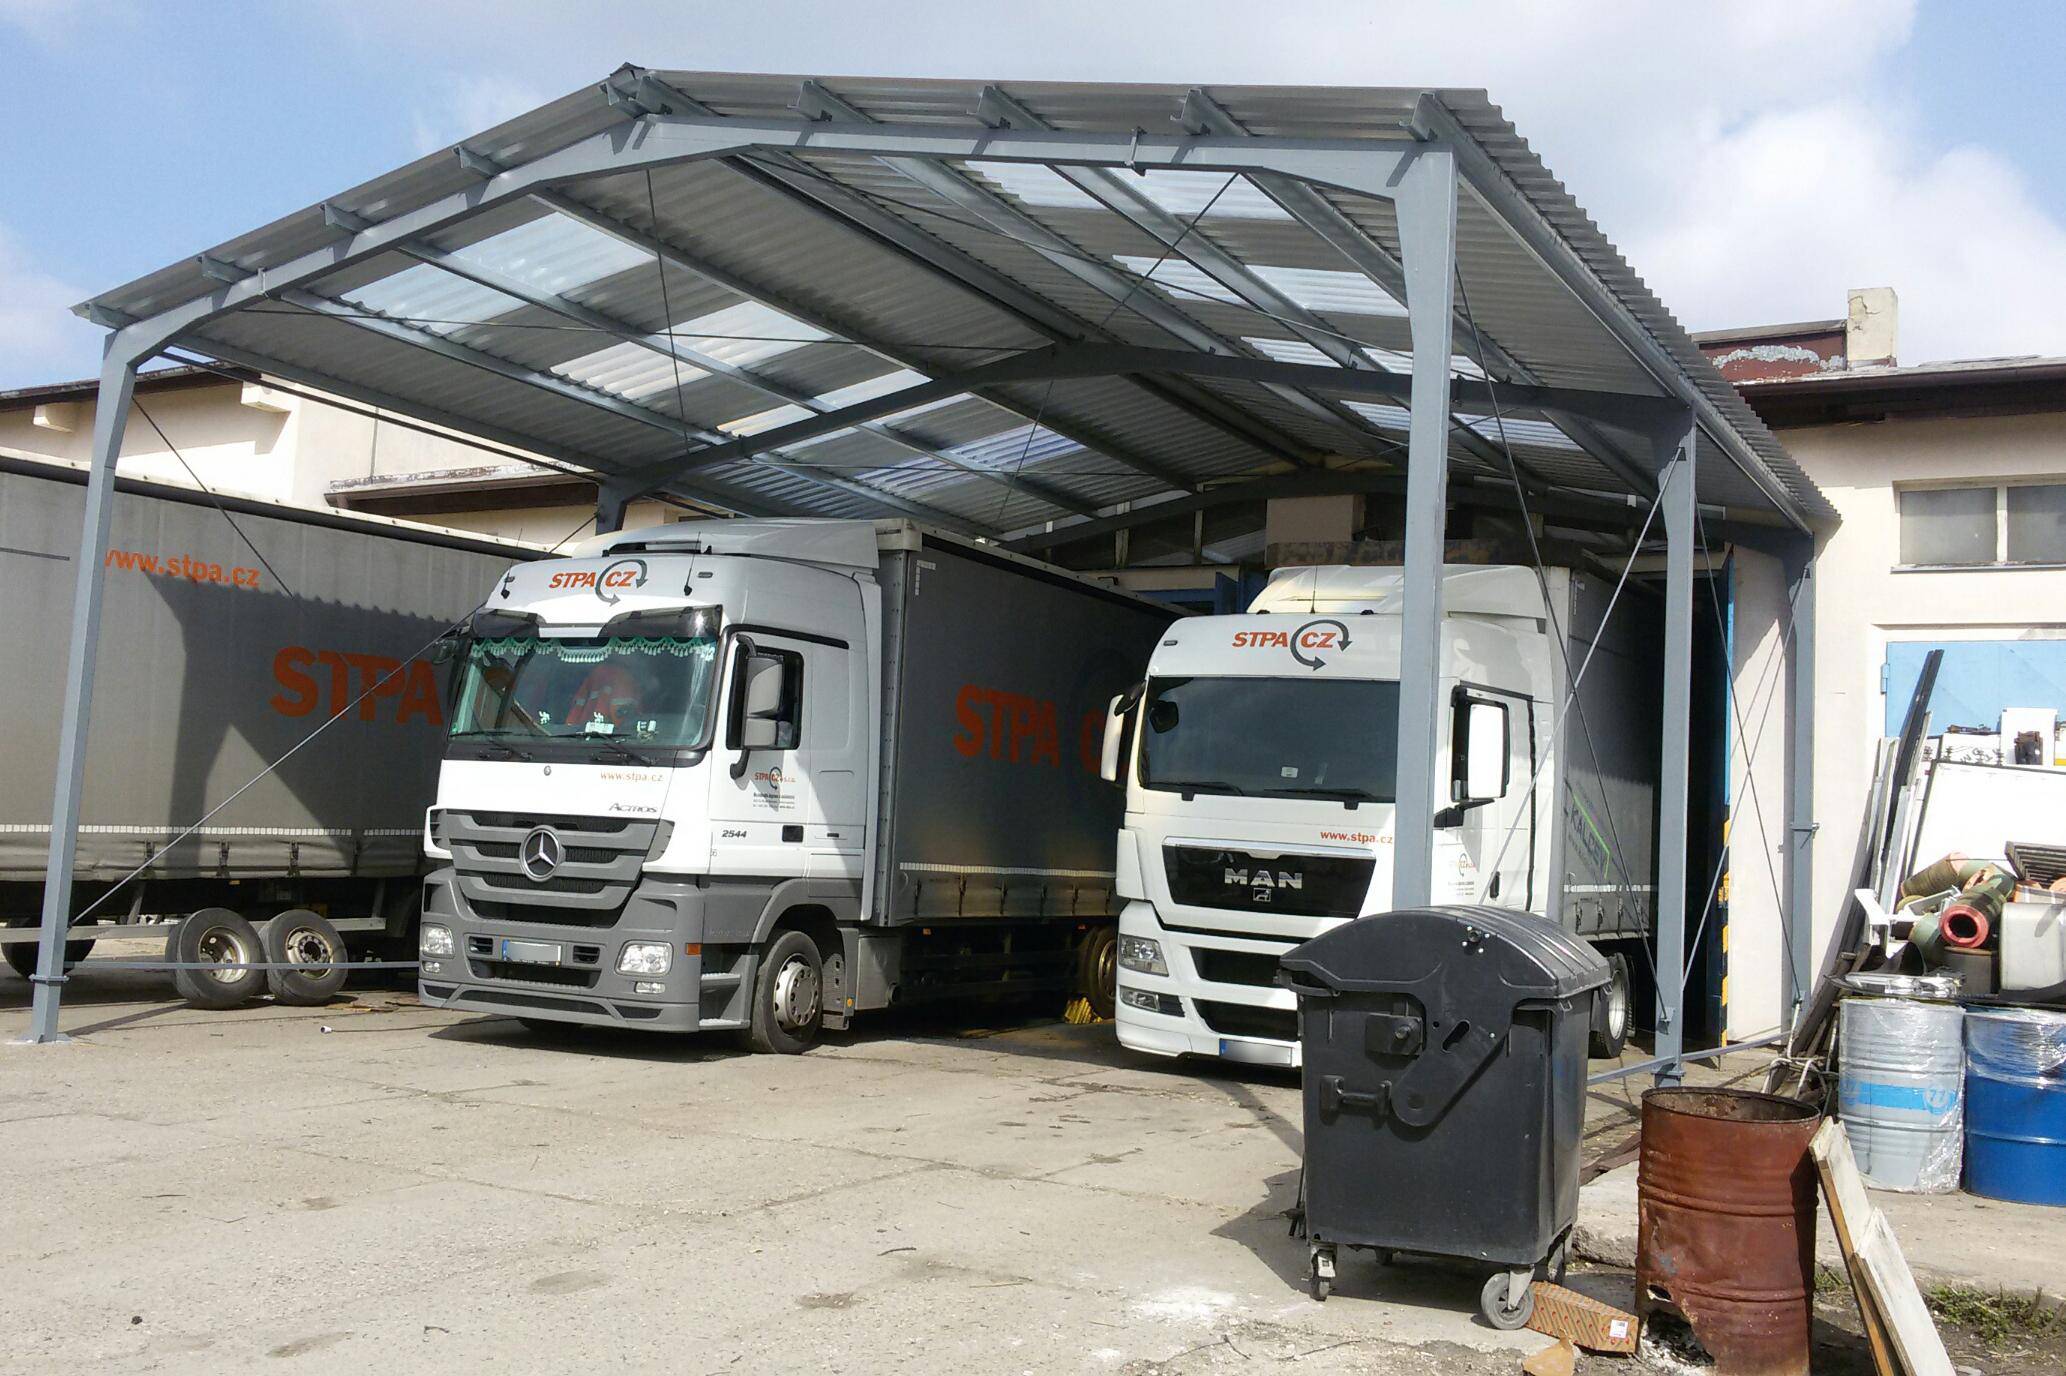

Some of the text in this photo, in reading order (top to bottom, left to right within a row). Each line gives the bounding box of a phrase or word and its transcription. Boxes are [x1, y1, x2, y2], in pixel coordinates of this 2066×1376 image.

[549, 570, 638, 589] STPA CZ
[1232, 631, 1337, 649] STPA CZ
[270, 645, 445, 726] STPA
[953, 684, 1060, 769] STPA
[600, 770, 664, 783] www.stpa.cz
[720, 829, 748, 839] 2544
[1320, 830, 1394, 845] www.stpa.cz
[1224, 867, 1303, 890] MAN
